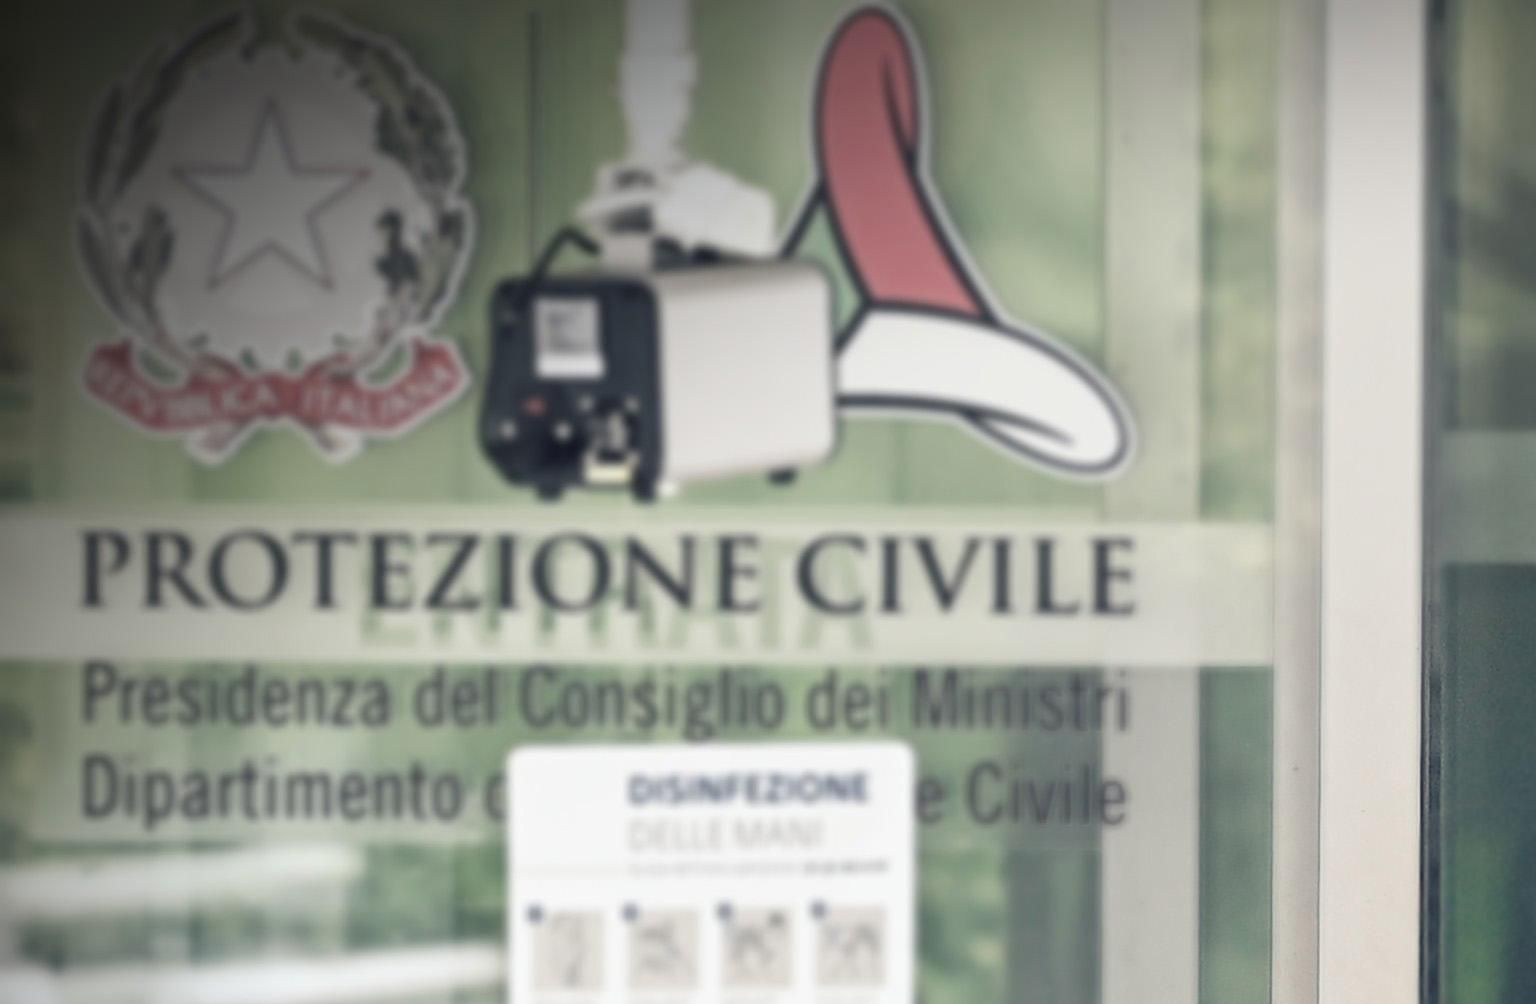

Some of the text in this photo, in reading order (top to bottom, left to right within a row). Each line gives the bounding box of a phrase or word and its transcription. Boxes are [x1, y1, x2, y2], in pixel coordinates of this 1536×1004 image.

[80, 528, 1136, 616] PROTEZIONE CIVILE
[82, 660, 1130, 742] Presidenza del Consiglio dei Ministri
[82, 753, 463, 830] Dipartimento
[966, 760, 1128, 825] Civile
[628, 774, 868, 806] DISINFEZIONE
